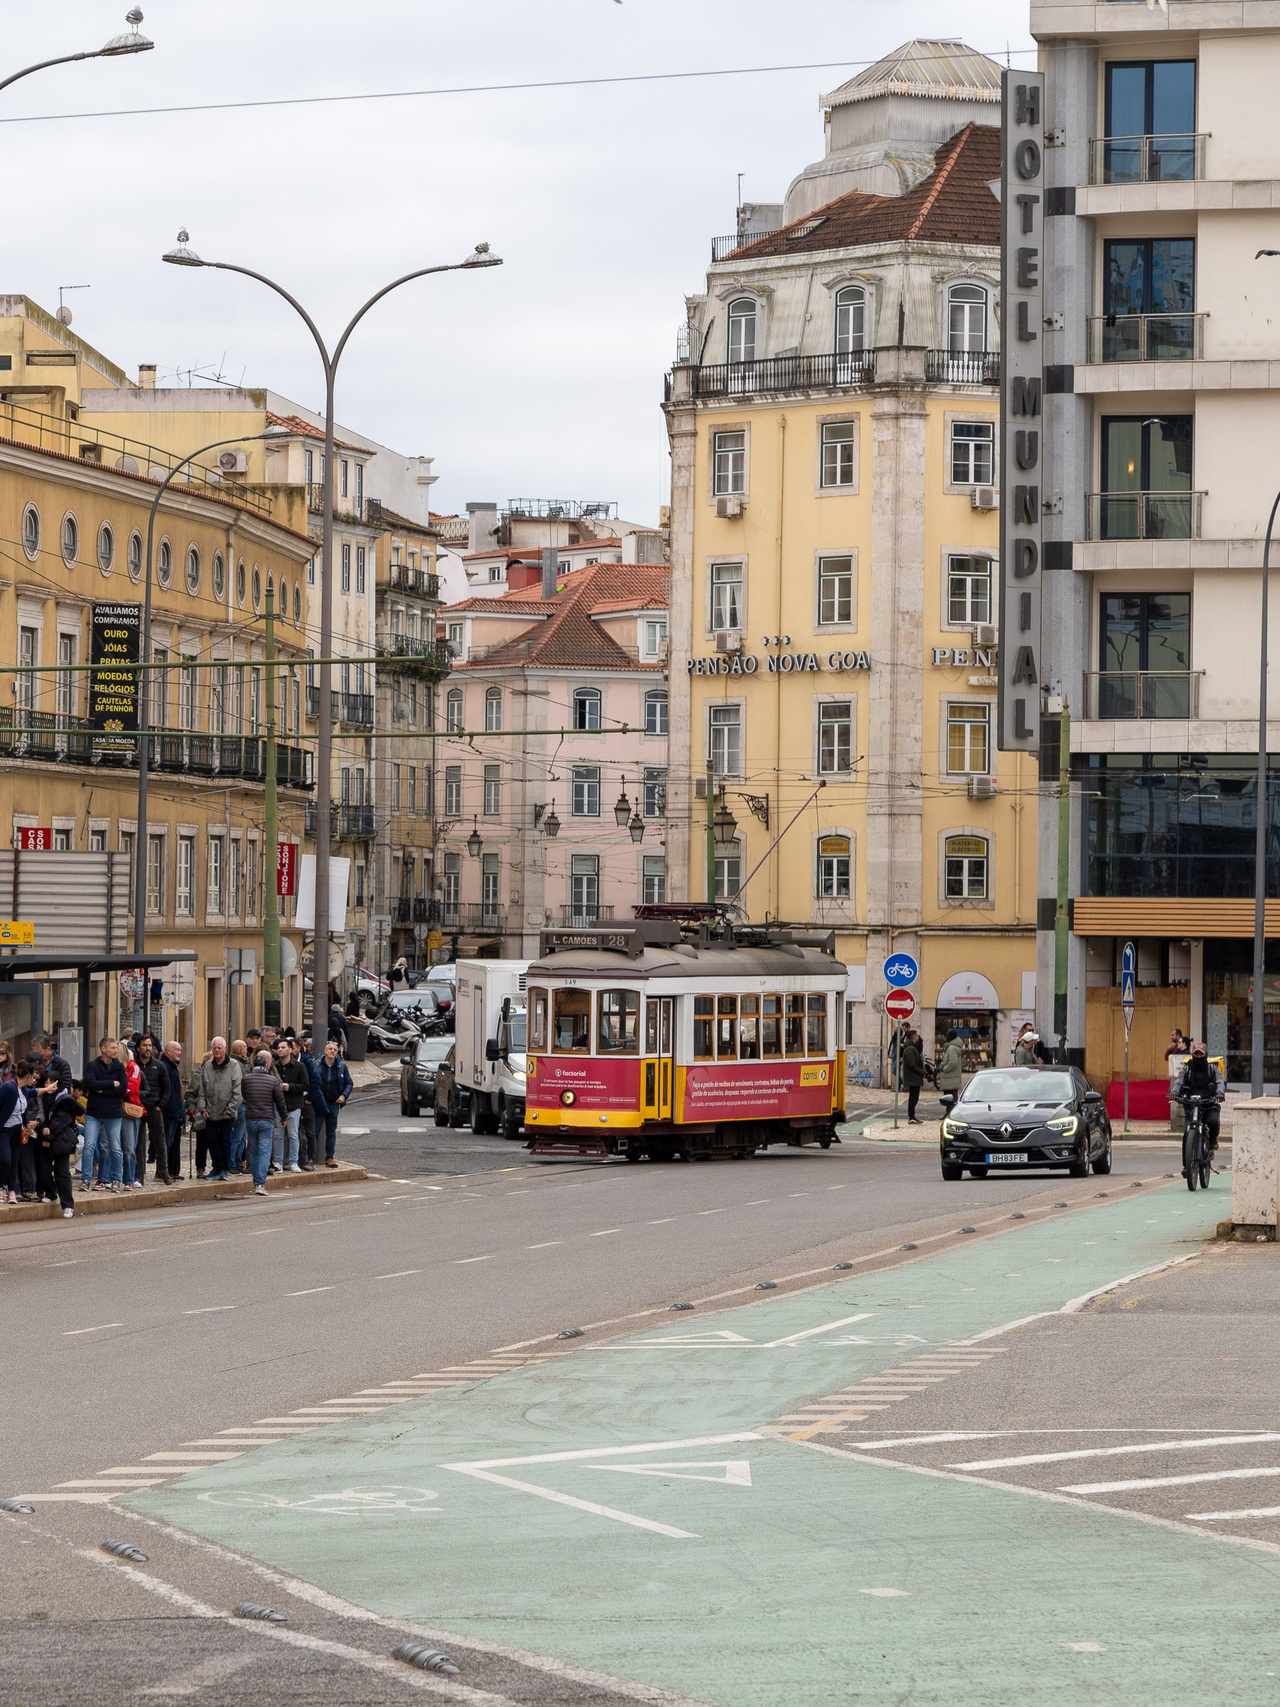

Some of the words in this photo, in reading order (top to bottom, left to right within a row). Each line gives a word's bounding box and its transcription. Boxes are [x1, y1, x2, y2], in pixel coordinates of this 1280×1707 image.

[1016, 84, 1040, 341] HOTEL
[1012, 376, 1041, 738] MUNDIAL
[95, 606, 139, 616] AVALIAMOS
[94, 616, 139, 626] COMPRAMOS
[104, 629, 129, 638] OURO
[104, 642, 128, 653] JÓIAS
[100, 657, 131, 665] PRATAS
[686, 652, 759, 675] PENSÃO
[766, 652, 818, 673] NOVA
[827, 650, 870, 670] GOA
[97, 672, 133, 681] MOEDAS
[94, 683, 136, 694] RELÓGIOS
[97, 697, 132, 705] CAUTELAS
[106, 704, 134, 712] PENHOR
[552, 935, 561, 944] L.
[562, 934, 598, 945] CAMÕES
[608, 935, 625, 946] 28
